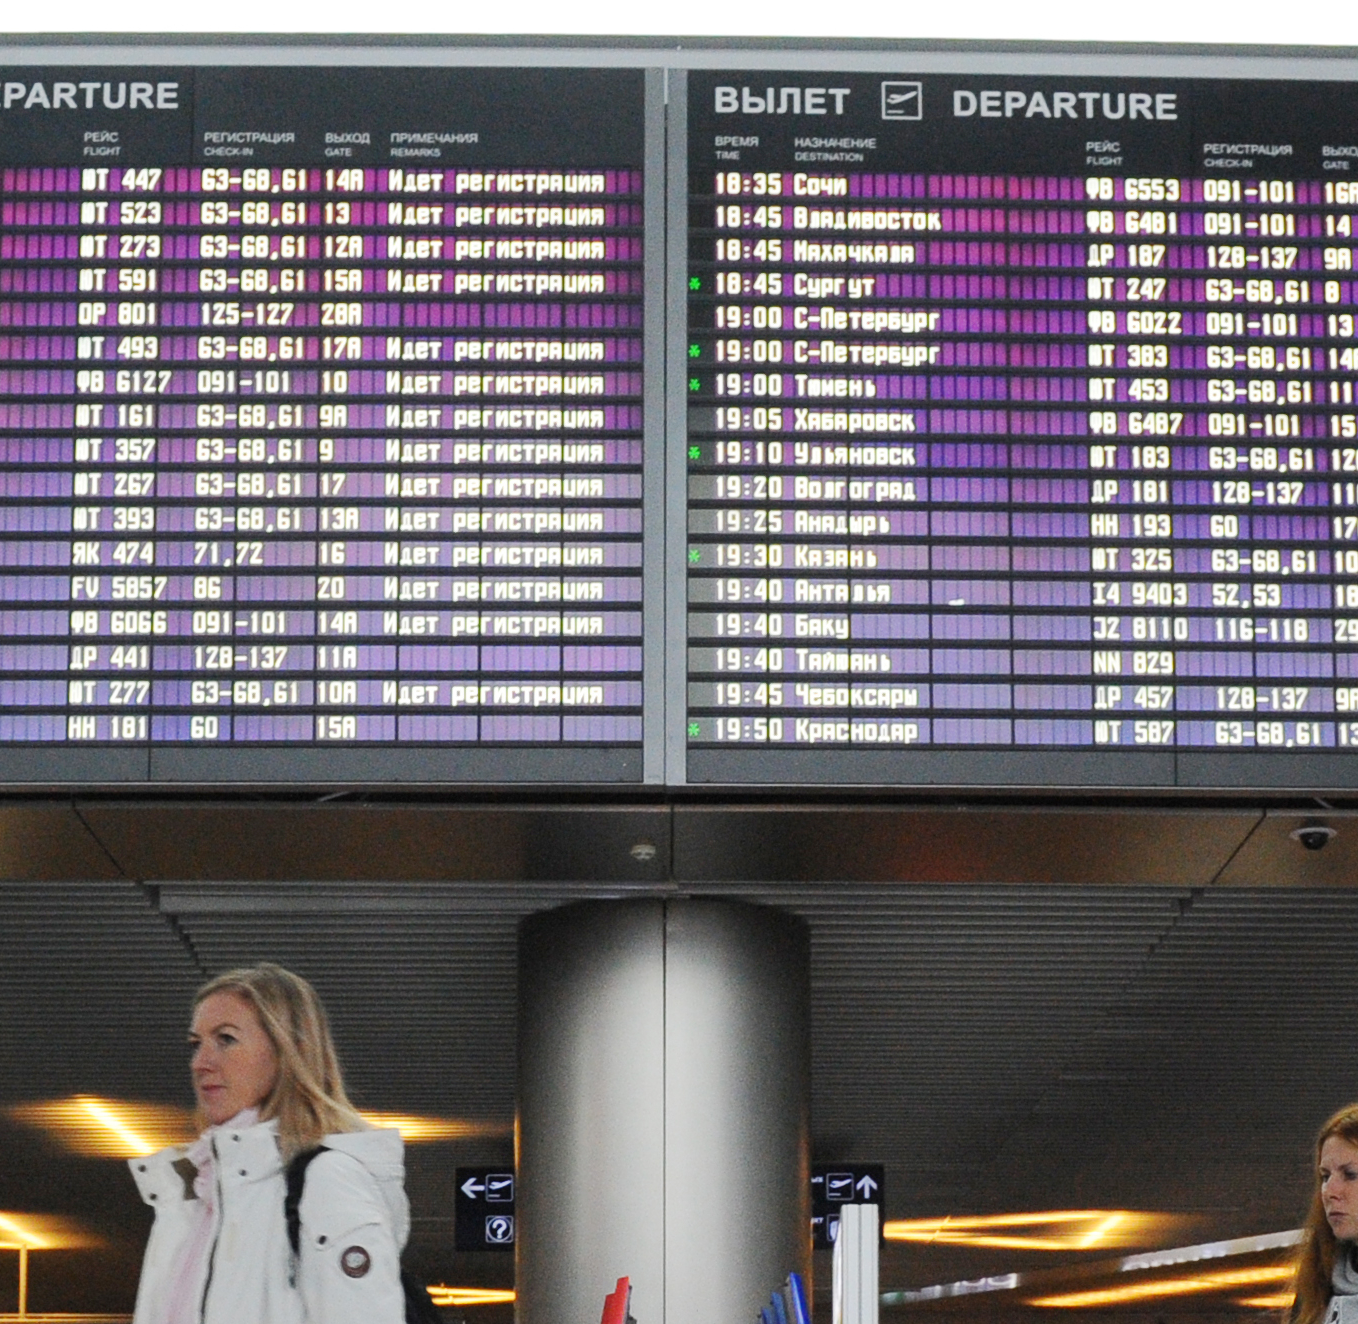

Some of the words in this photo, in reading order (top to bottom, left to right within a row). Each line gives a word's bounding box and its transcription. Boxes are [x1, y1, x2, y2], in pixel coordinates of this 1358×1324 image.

[715, 86, 851, 115] ВЫЛЕТ
[953, 90, 1178, 120] DEPARTURE
[83, 130, 119, 145] РЕЙС
[203, 131, 296, 145] РЕГИСТРАЦИЯ
[324, 131, 371, 145] ВЫХОД
[390, 132, 479, 144] ПРИМЕЧАНИЯ
[714, 135, 760, 147] ВРЕМЯ
[794, 136, 877, 149] НАЗНАЧЕНИЕ
[1085, 140, 1120, 153] РЕЙС
[1203, 143, 1293, 157] РЕГИСТРАЦИЯ
[82, 145, 122, 157] FLIGHT
[203, 145, 254, 157] CHECK-IN
[323, 146, 353, 158] GATE
[389, 147, 442, 158] REMARKS
[715, 150, 740, 161] TIME
[794, 151, 864, 162] DESTINATION
[1085, 155, 1123, 166] FLIGHT
[1203, 158, 1253, 168] CHECK-IN
[1322, 160, 1349, 170] GATE
[120, 201, 161, 224] 523
[326, 202, 350, 225] 13
[388, 202, 443, 226] Идет
[455, 207, 604, 228] регистрация
[716, 206, 782, 228] 18:45
[793, 206, 941, 231] Владивосток
[1204, 212, 1294, 236] 091-101
[1326, 215, 1350, 237] 14
[116, 370, 172, 393] 6127
[197, 370, 289, 393] 091-101
[323, 371, 347, 393] 10
[386, 371, 441, 395] Идет
[454, 375, 604, 396] регистрация
[716, 373, 782, 396] 19:00
[794, 374, 876, 398] Тюмень
[1128, 378, 1168, 401] 453
[1330, 381, 1352, 404] 11
[112, 541, 153, 565] 474
[320, 542, 345, 565] 16
[384, 542, 440, 566] Идет
[452, 546, 603, 568] регистрация
[716, 613, 783, 636] 19:40
[794, 613, 849, 639] Баку
[1132, 616, 1188, 640] 8110
[1215, 618, 1308, 642] 116-118
